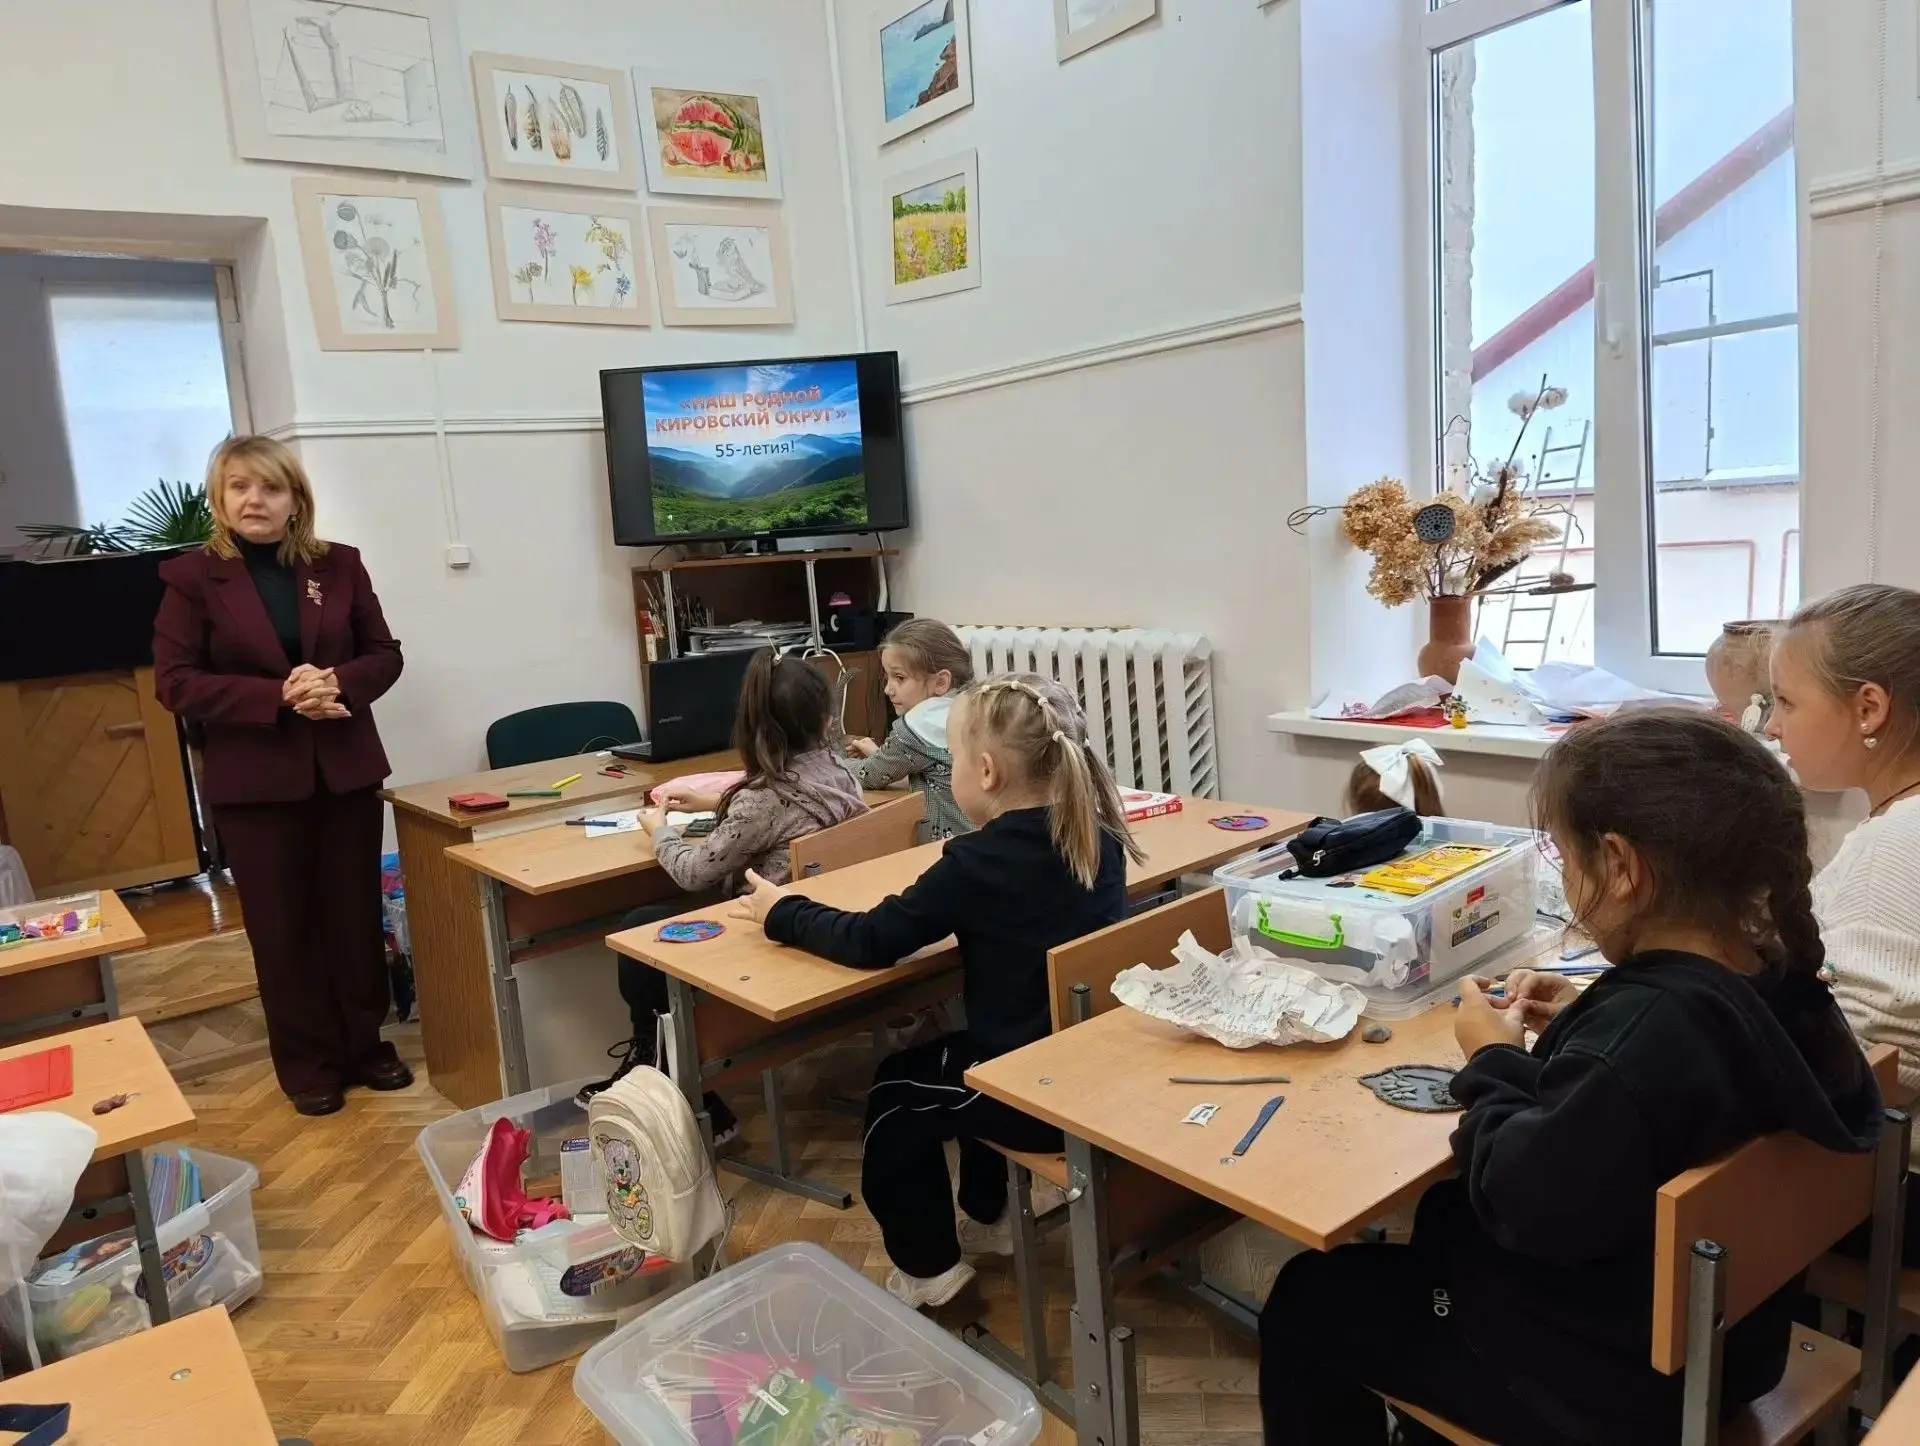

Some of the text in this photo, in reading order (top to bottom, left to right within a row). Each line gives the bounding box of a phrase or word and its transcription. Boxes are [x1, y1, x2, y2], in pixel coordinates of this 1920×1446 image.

[680, 385, 821, 411] «НАШ РОДНОЙ
[655, 408, 770, 432] КИРОВСКИЙ
[715, 440, 796, 458] 55-летия!
